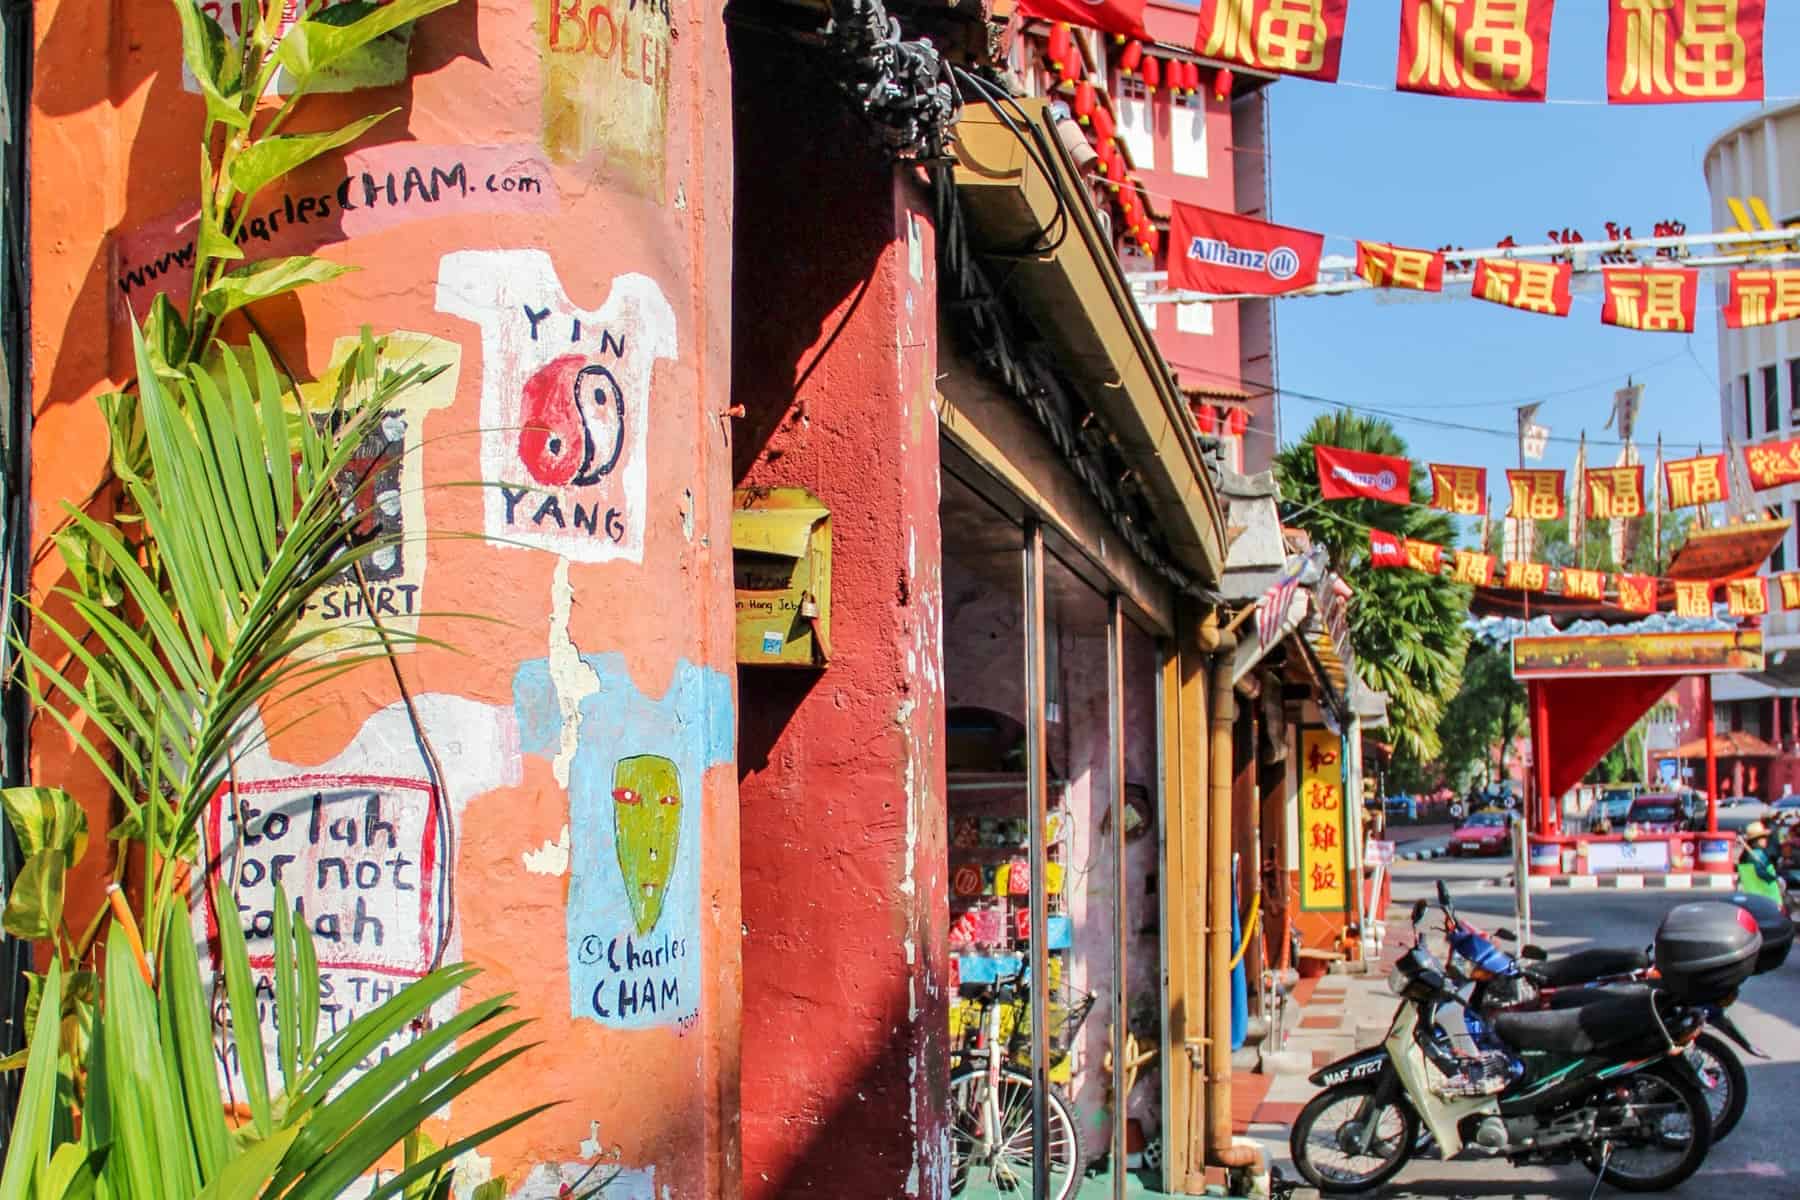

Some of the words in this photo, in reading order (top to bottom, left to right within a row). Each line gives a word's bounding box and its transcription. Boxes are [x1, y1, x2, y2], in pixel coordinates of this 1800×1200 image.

[1190, 239, 1266, 270] Allianz
[523, 304, 625, 359] YIN
[501, 487, 626, 543] YANG
[228, 799, 290, 846] to
[308, 791, 397, 849] lah
[240, 854, 296, 888] or
[317, 851, 415, 891] not
[592, 976, 680, 1019] CHAM
